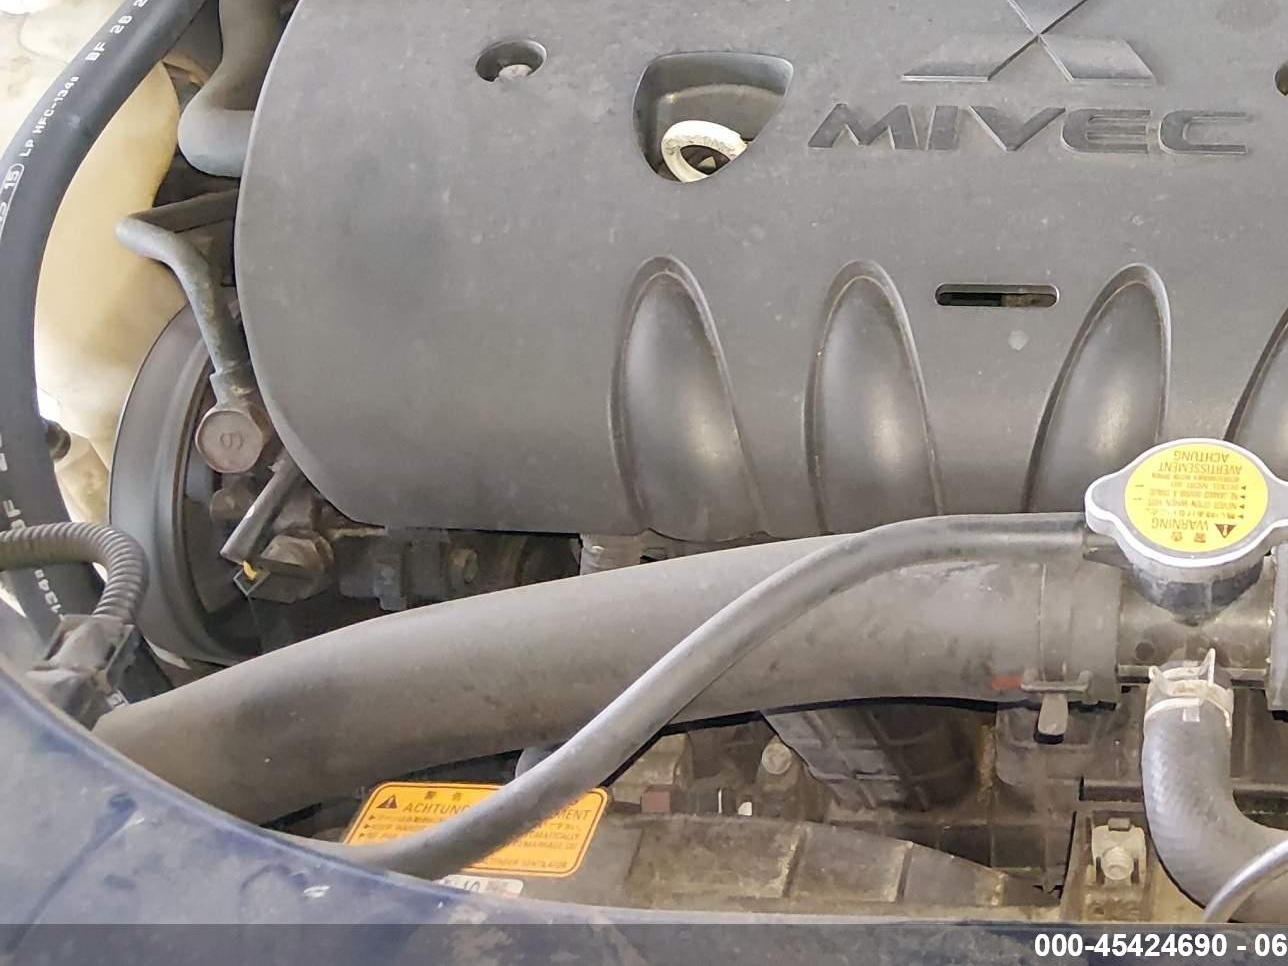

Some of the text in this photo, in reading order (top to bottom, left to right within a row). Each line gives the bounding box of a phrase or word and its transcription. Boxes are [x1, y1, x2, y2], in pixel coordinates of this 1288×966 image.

[19, 138, 35, 157] LP
[32, 75, 80, 134] HFC-134a
[806, 102, 1250, 156] MIVEC
[1173, 449, 1230, 462] ACHTUNG
[1157, 461, 1243, 475] AVERTISSEMENT
[1151, 517, 1209, 532] WARNING
